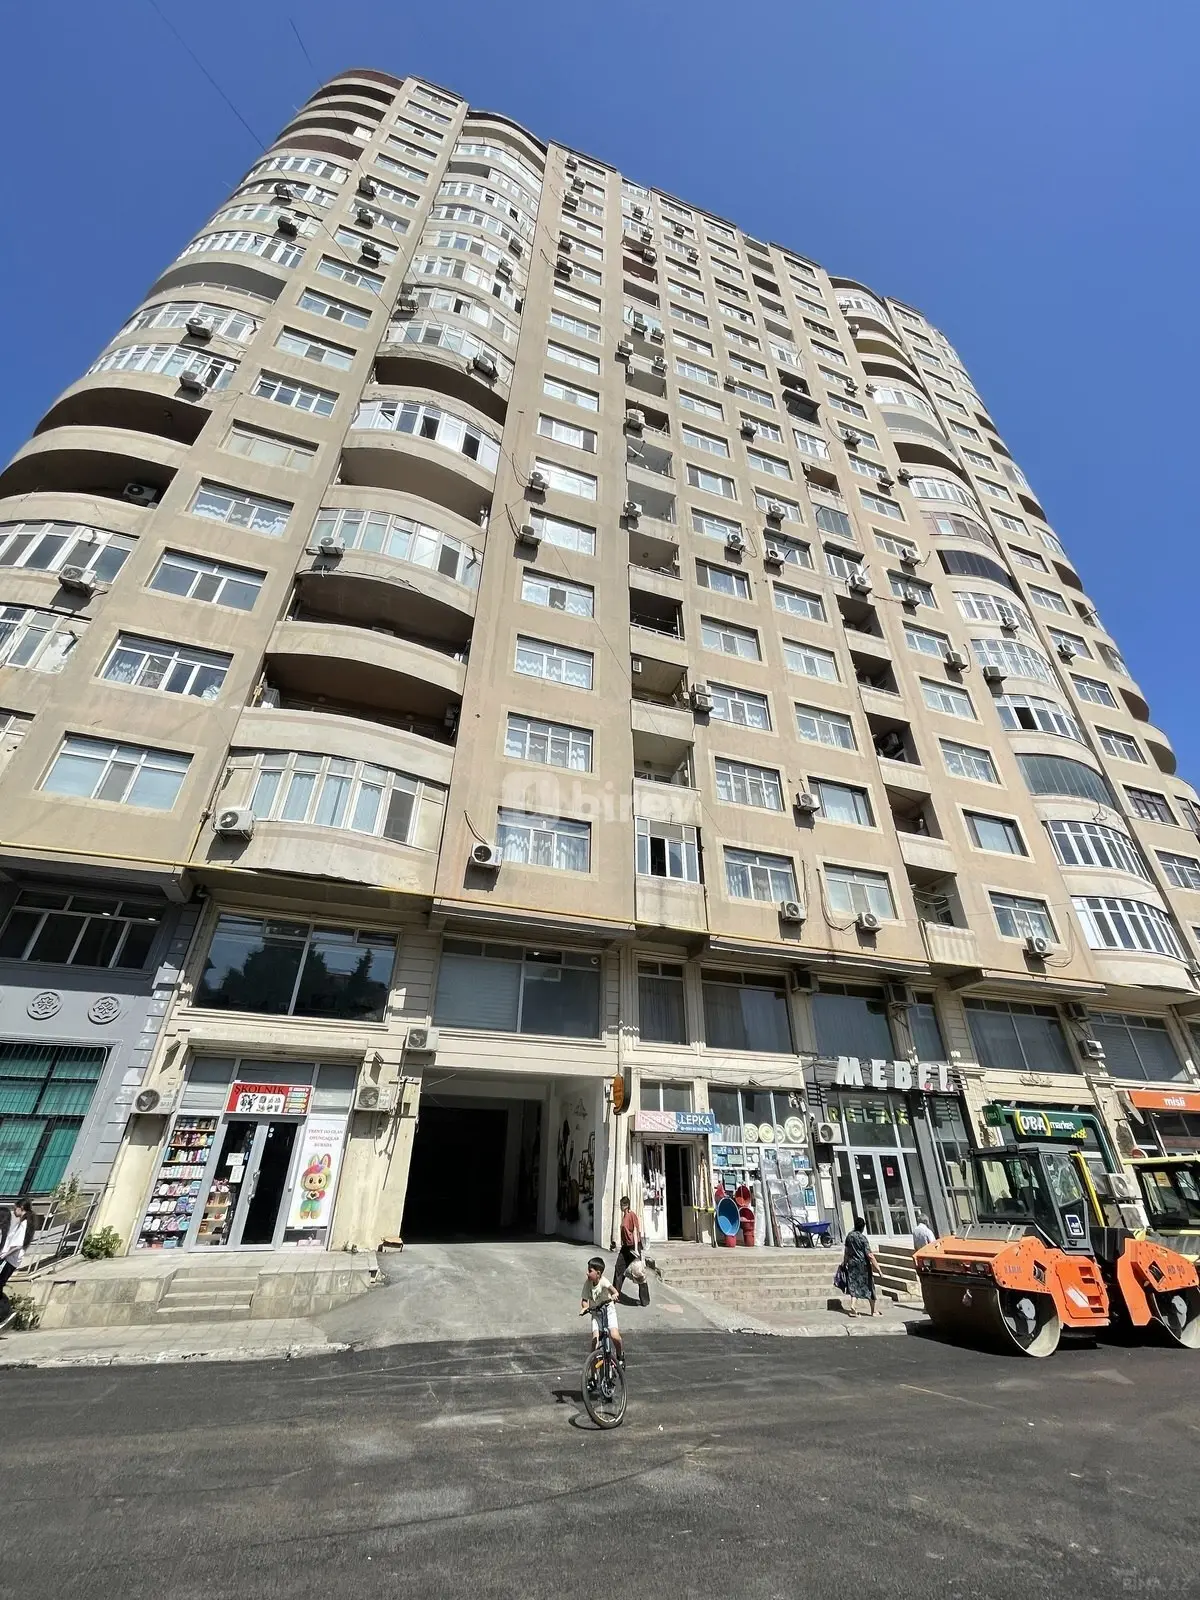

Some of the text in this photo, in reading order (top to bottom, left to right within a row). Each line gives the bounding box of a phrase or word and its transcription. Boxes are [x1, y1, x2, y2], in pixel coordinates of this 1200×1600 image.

[836, 1056, 955, 1092] MEBEL
[1163, 1096, 1186, 1107] misli
[1020, 1115, 1076, 1132] OBA market
